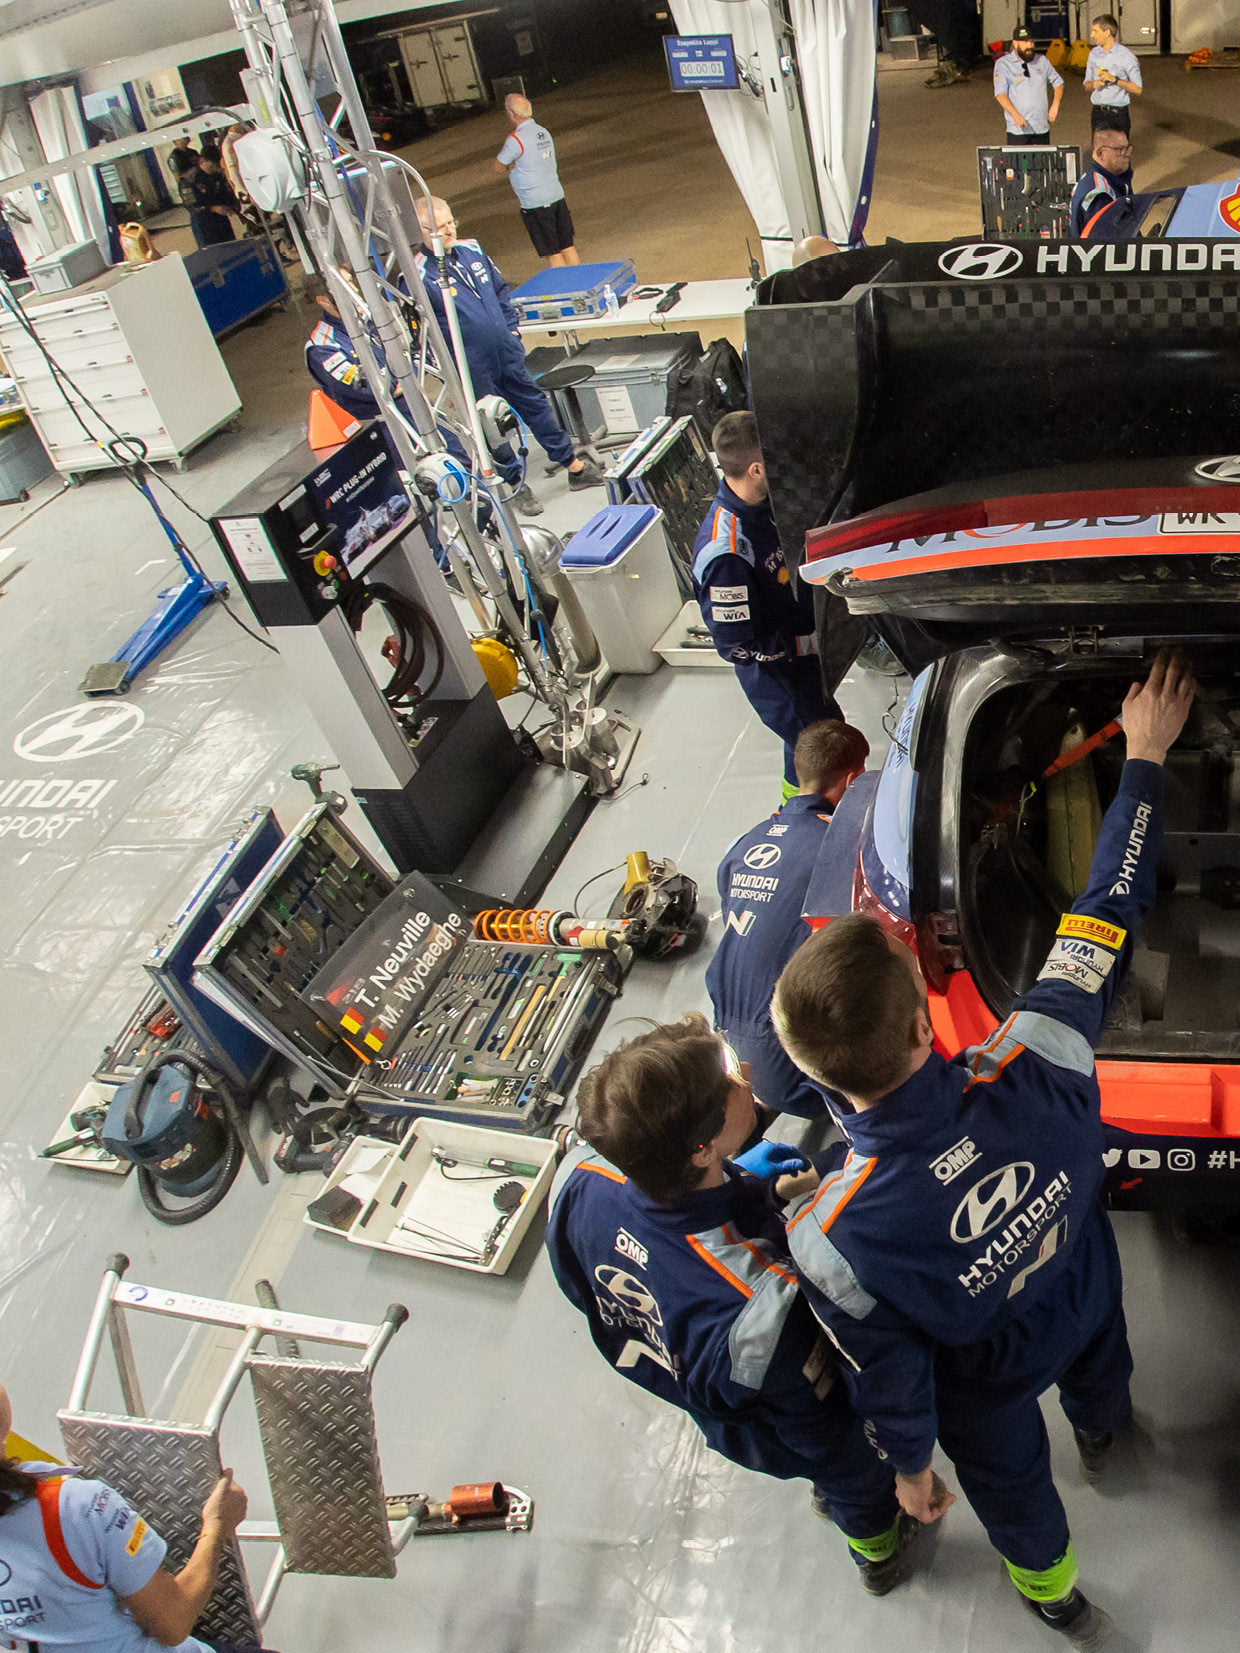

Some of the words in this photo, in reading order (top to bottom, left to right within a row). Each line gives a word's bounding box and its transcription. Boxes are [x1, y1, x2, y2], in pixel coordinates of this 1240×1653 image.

[681, 63, 722, 74] 00:00:01
[329, 488, 345, 504] WRC
[343, 468, 367, 493] PLUG-IN
[1119, 801, 1153, 882] HYUNDAI
[731, 873, 779, 891] HYUNDAI
[1066, 919, 1120, 944] PIRELLI
[354, 988, 380, 1008] T.
[369, 911, 431, 990] Neuville
[1060, 940, 1096, 960] WIA
[378, 1003, 404, 1030] M.
[393, 912, 462, 1002] Wydaeghe
[1049, 965, 1089, 979] MOBIS
[934, 1140, 977, 1181] OMP
[957, 1170, 1069, 1288] HYUNDAI
[967, 1182, 1072, 1298] MOTORSPORT
[616, 1233, 649, 1265] OMP
